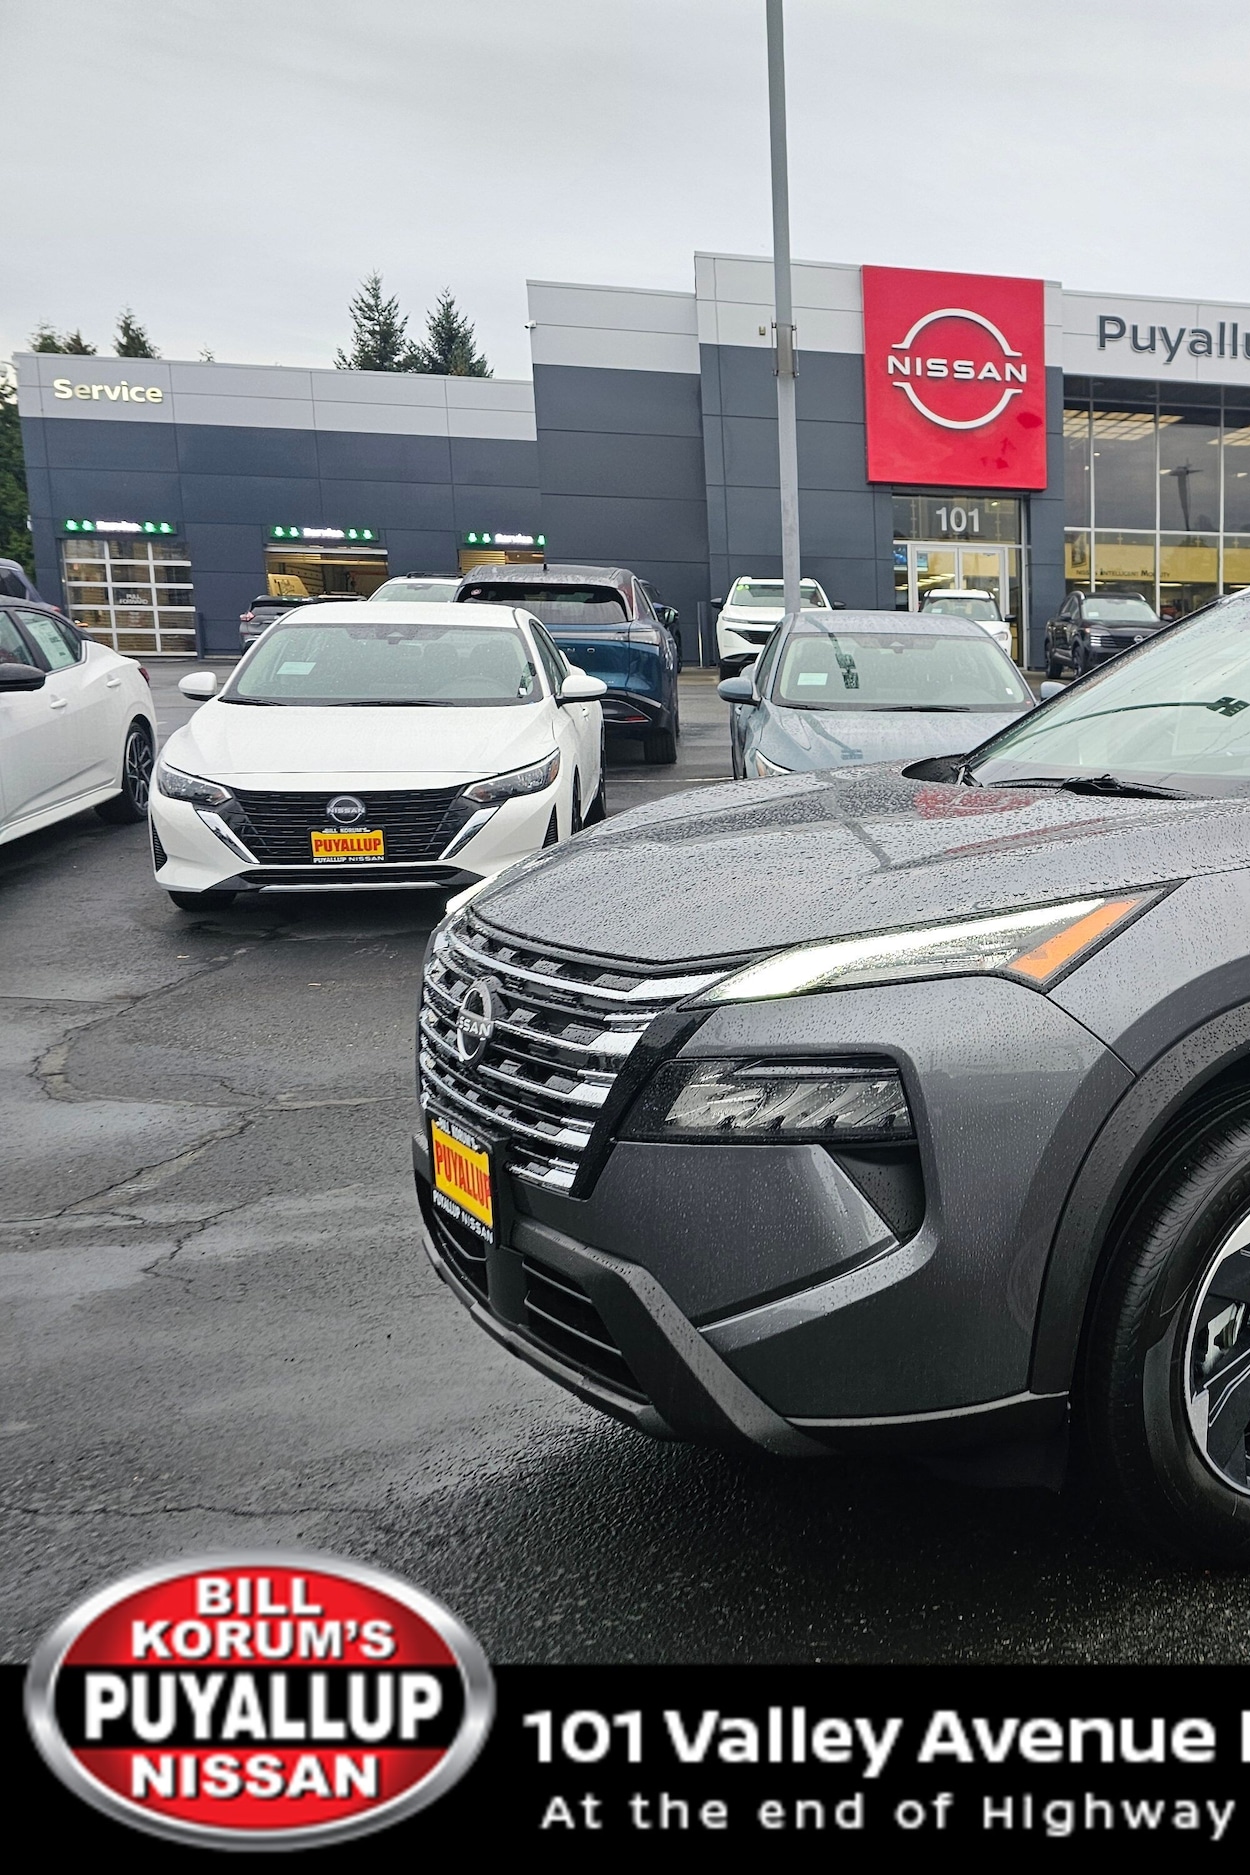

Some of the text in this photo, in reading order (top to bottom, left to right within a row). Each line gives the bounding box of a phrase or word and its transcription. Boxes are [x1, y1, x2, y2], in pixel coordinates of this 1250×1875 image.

[887, 354, 1028, 384] NISSAN
[53, 378, 163, 404] Service
[935, 506, 980, 533] 101
[326, 806, 366, 815] NISSAN
[314, 838, 382, 852] PUYALLUP
[435, 1139, 492, 1211] PUYALLUP
[461, 1210, 494, 1245] NISSAN
